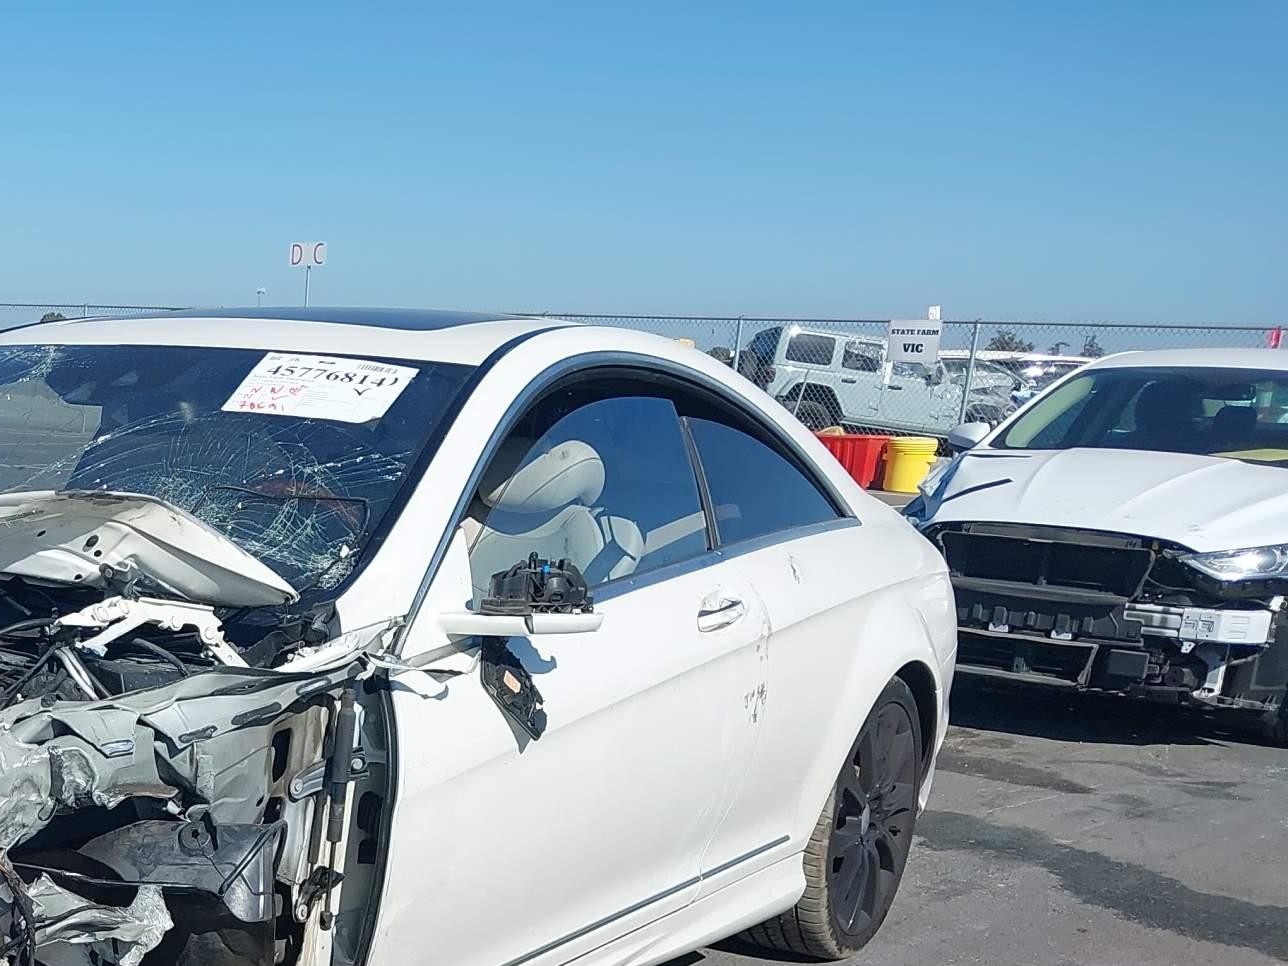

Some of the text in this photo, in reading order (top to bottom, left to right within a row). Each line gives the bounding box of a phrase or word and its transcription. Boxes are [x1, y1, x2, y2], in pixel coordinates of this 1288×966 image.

[292, 243, 325, 265] D C
[891, 328, 940, 336] STATE FARM
[903, 343, 924, 354] VIC
